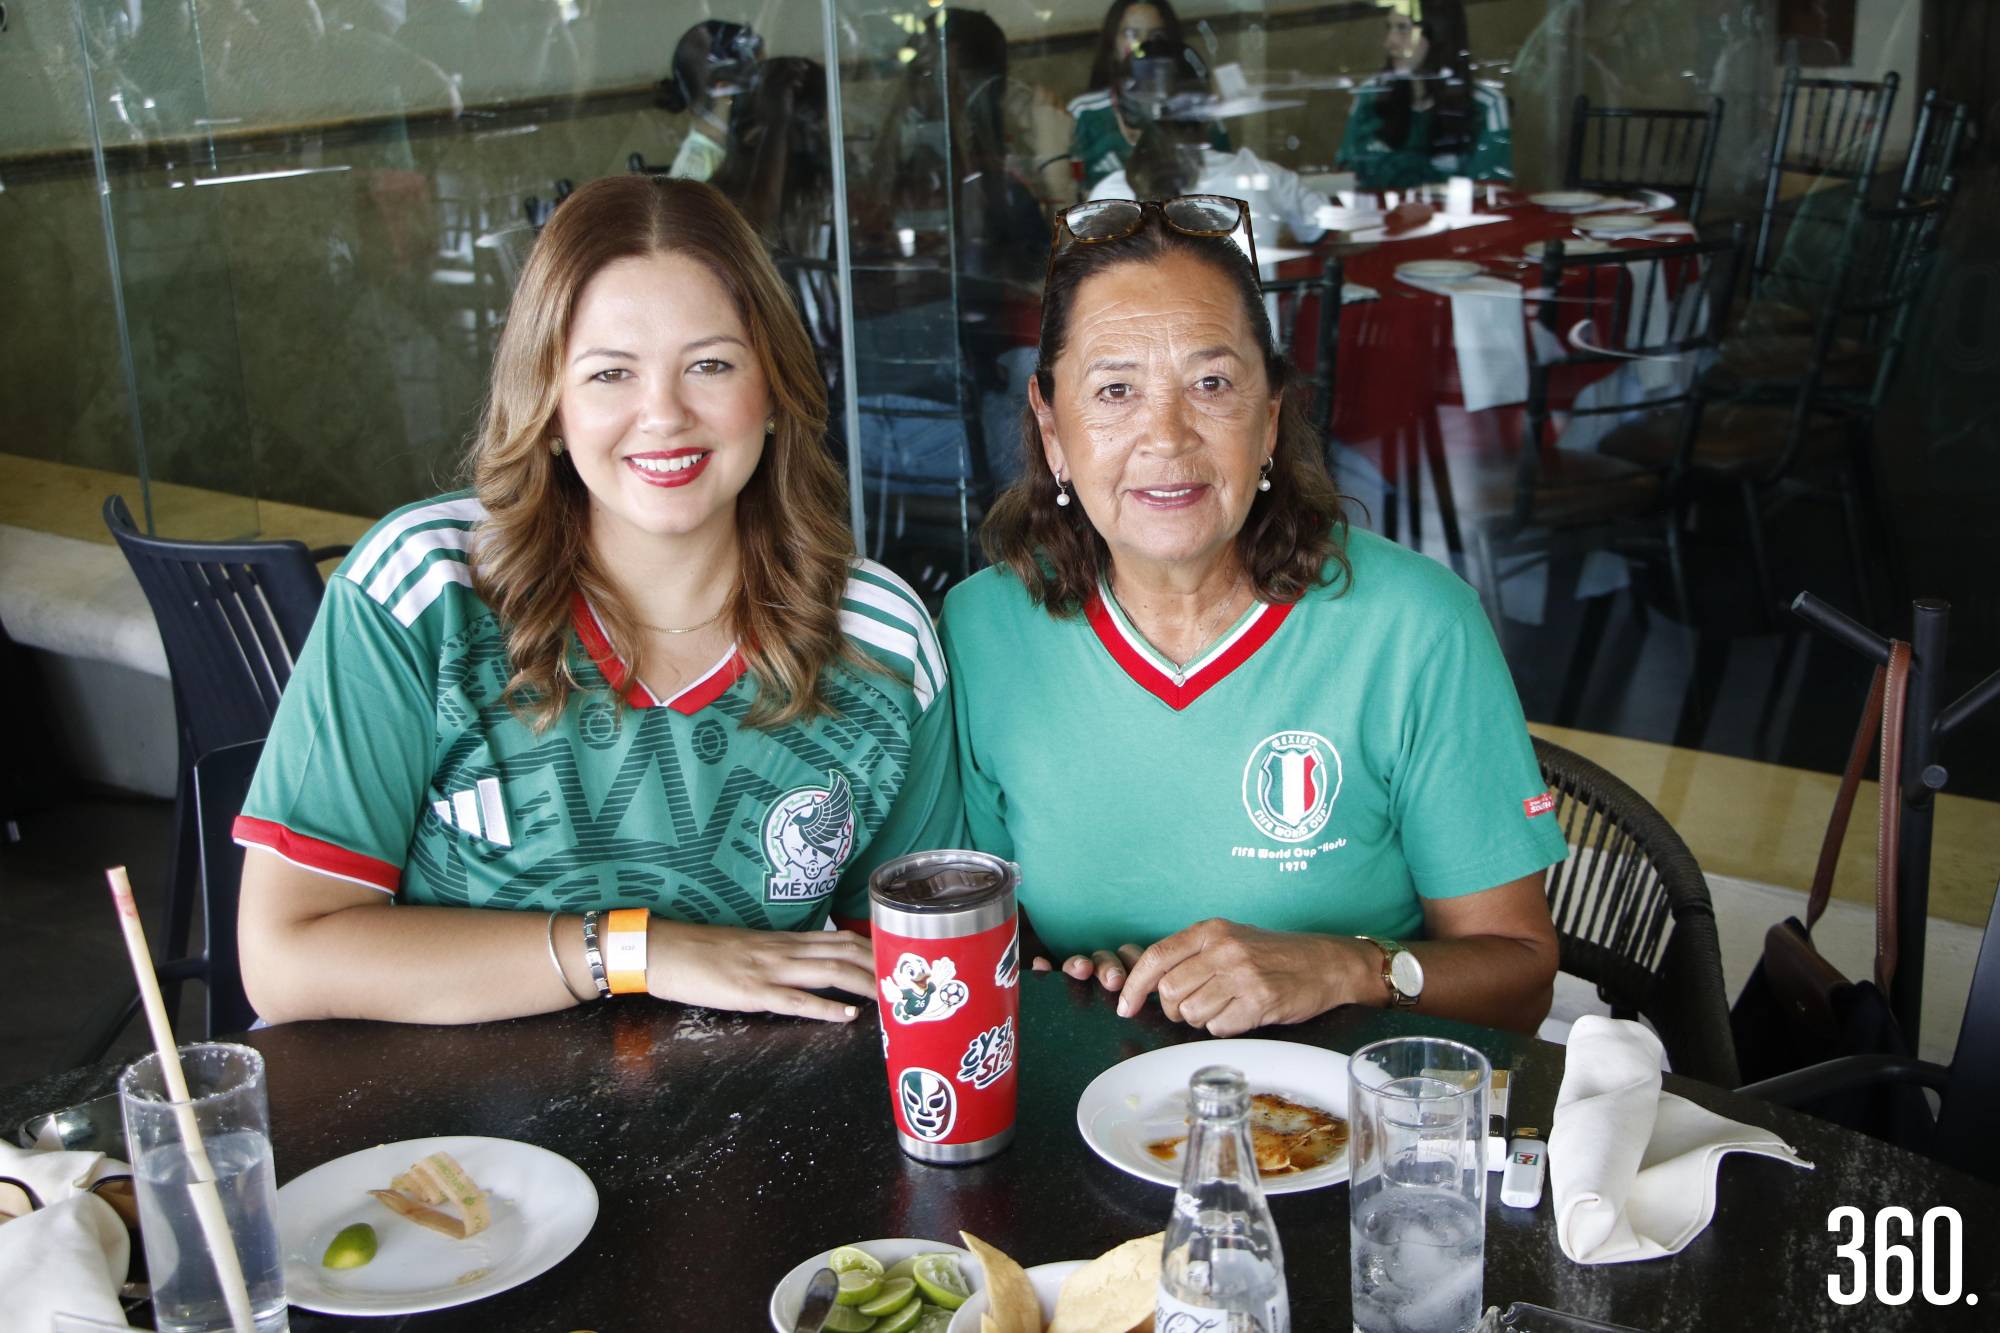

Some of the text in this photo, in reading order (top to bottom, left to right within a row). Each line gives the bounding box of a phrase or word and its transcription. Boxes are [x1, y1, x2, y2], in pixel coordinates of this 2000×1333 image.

[1254, 809, 1274, 831] FIFA
[1231, 846, 1256, 858] FIFA
[1257, 848, 1292, 860] World
[1279, 860, 1308, 872] 1970
[772, 878, 836, 897] MÉXICO
[914, 999, 926, 1008] 26
